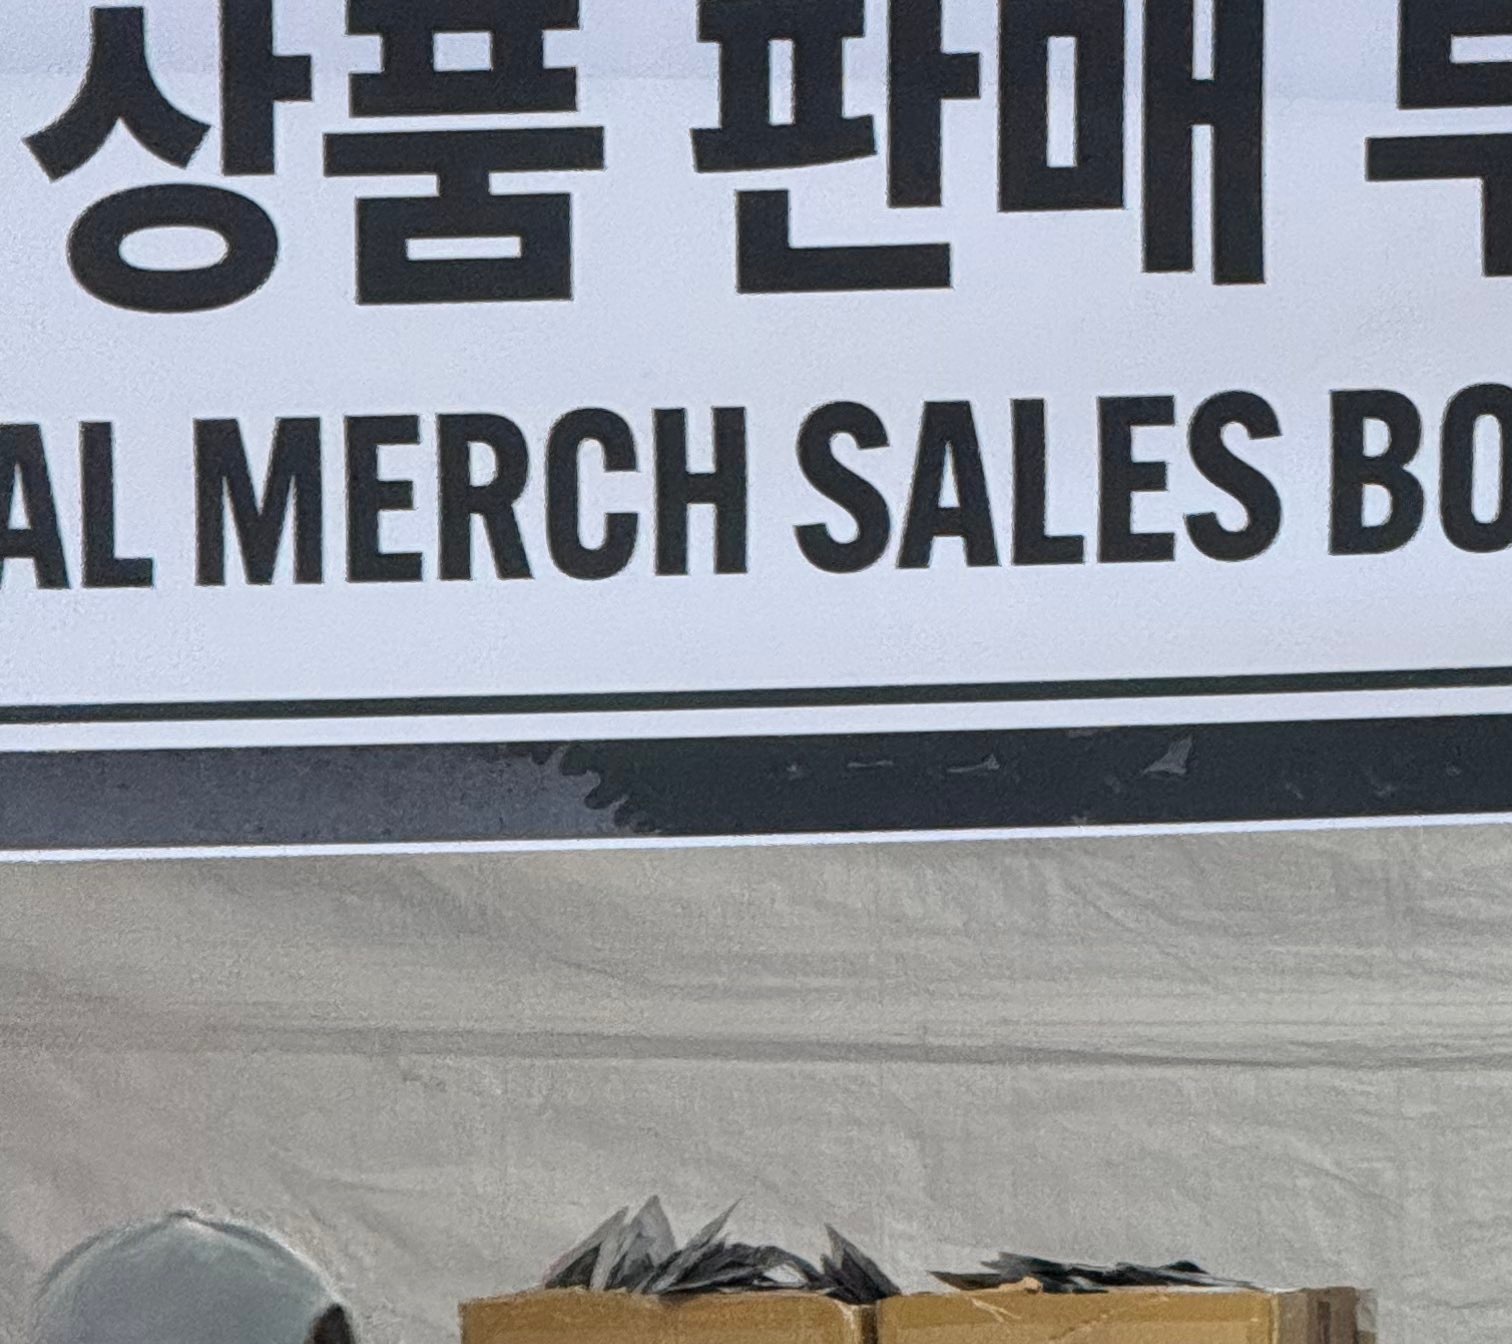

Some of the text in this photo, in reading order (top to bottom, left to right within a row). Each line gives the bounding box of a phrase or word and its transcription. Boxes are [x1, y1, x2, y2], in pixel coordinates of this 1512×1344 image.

[22, 0, 605, 314] 상품
[690, 0, 1266, 294] 판매
[0, 422, 155, 590] AL
[194, 406, 748, 586] MERCH
[794, 390, 1282, 574] SALES
